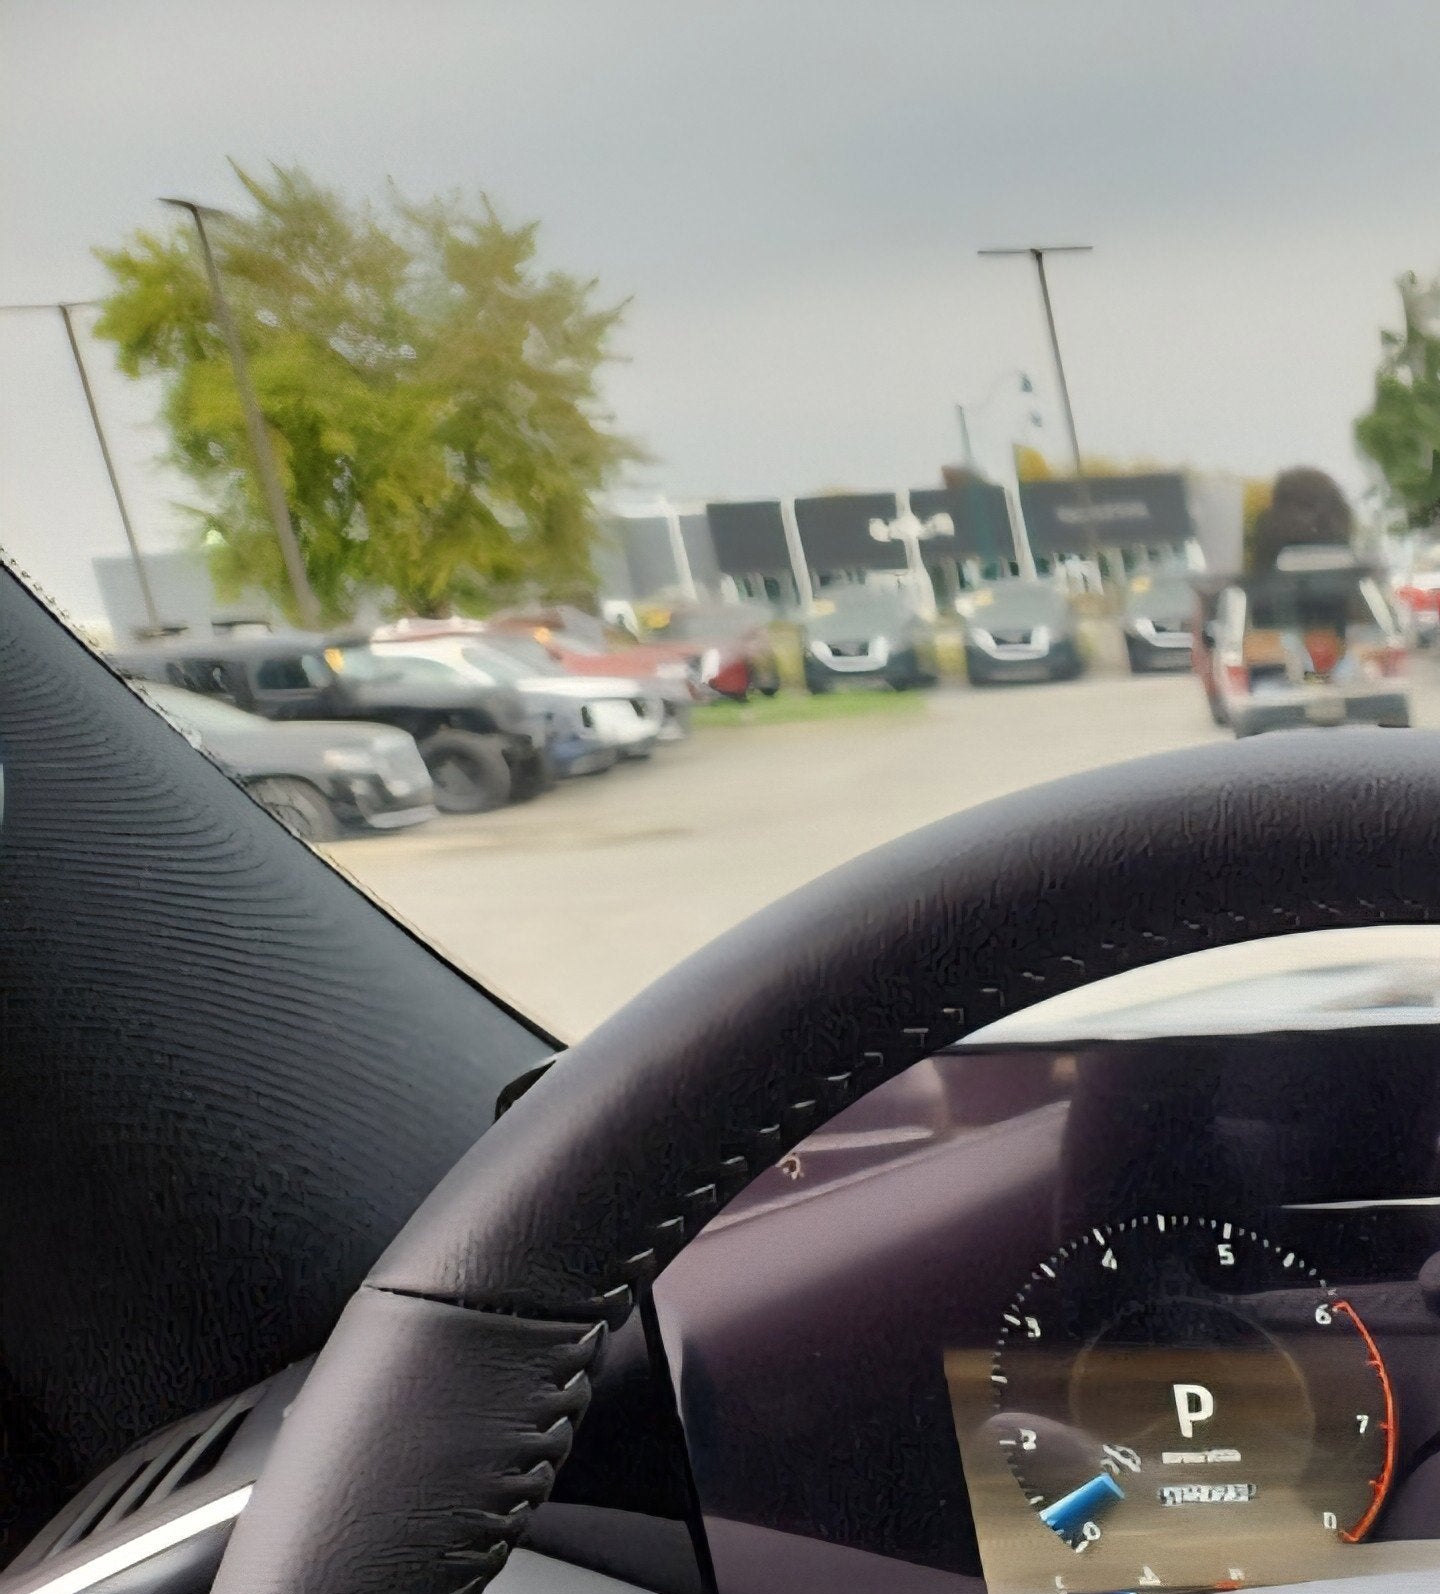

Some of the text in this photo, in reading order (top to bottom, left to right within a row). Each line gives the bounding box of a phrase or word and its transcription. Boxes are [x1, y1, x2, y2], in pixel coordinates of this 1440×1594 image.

[1217, 1243, 1235, 1266] 5
[1172, 1382, 1215, 1439] P
[1355, 1413, 1370, 1434] 7
